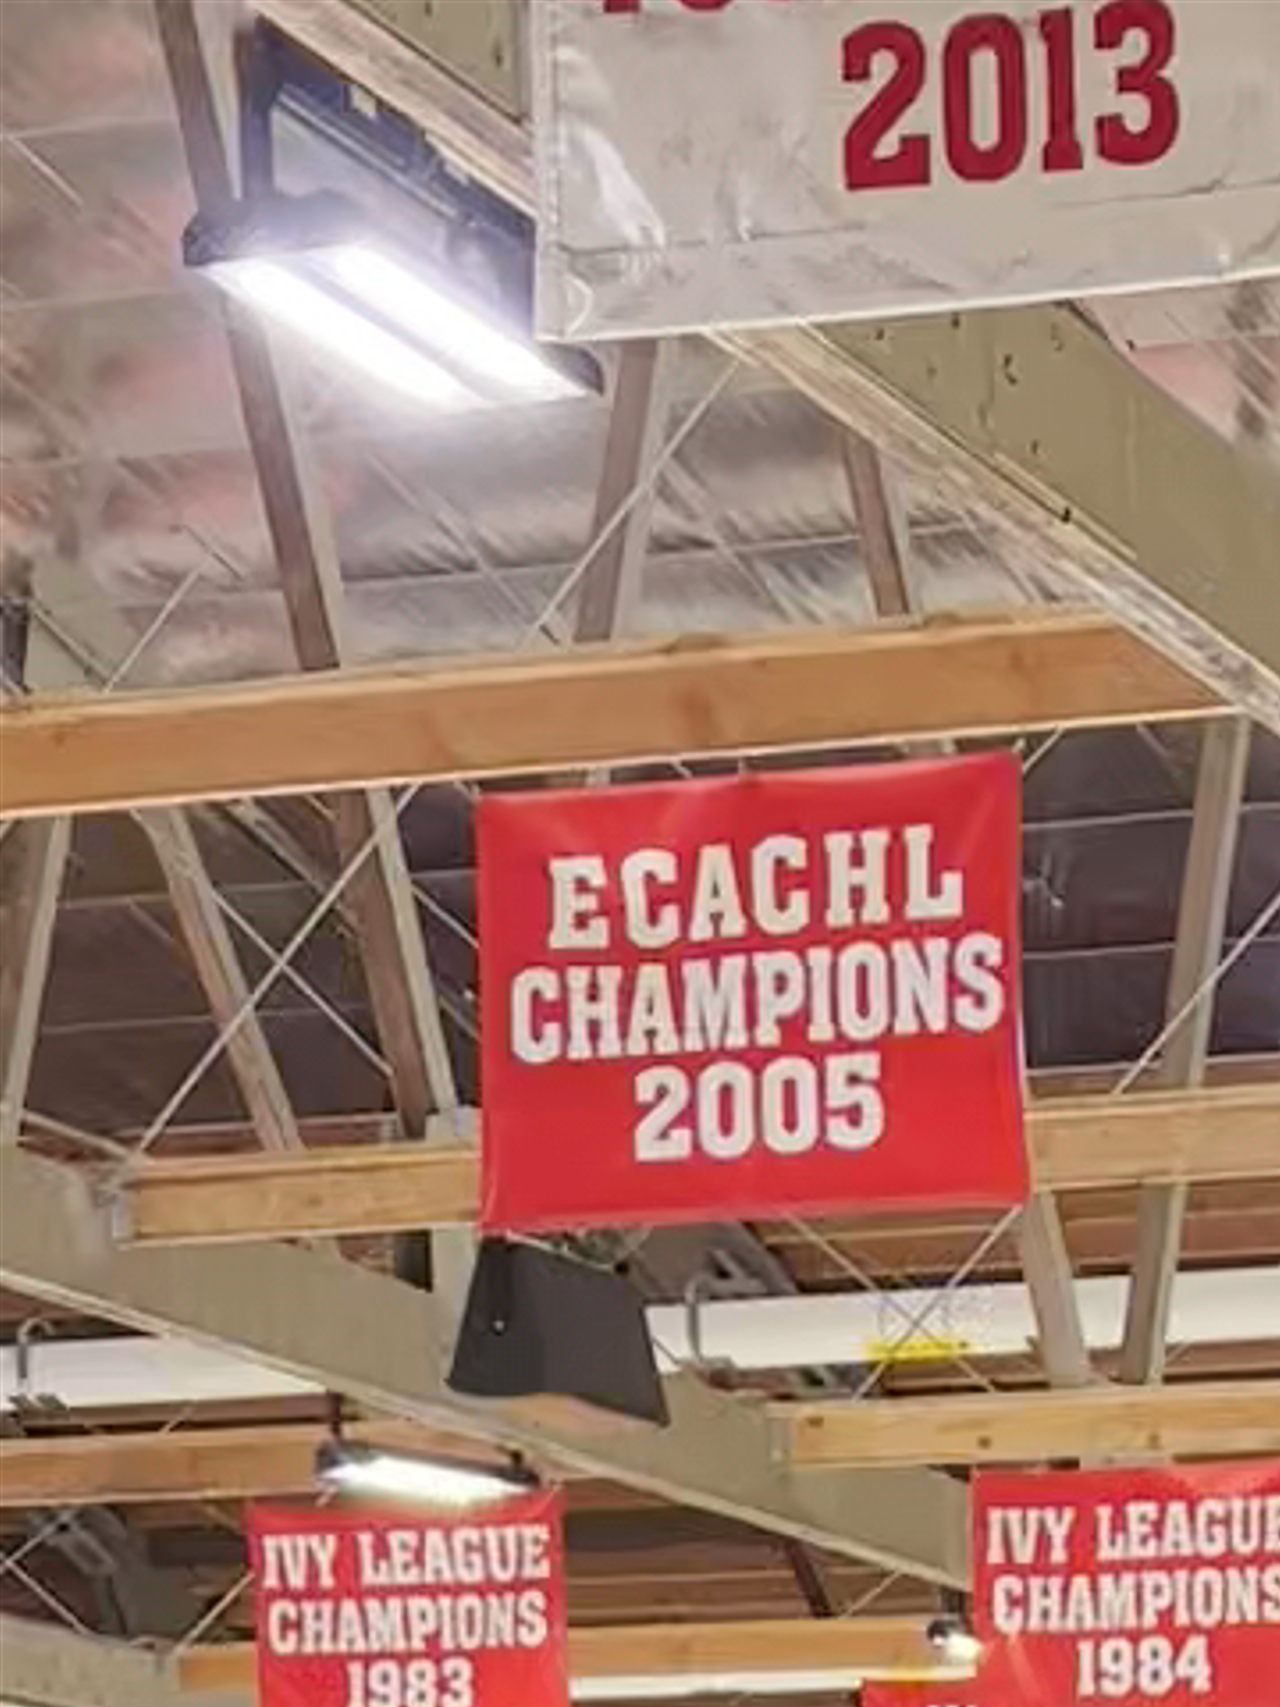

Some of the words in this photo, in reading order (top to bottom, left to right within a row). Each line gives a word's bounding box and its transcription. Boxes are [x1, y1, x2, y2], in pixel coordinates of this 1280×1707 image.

[841, 0, 1183, 192] 2013
[546, 822, 963, 955] ECACHL
[510, 933, 1003, 1066] CHAMPIONS
[634, 1053, 886, 1167] 2005
[261, 1534, 338, 1592] IVY
[359, 1523, 552, 1585] LEAGUE
[986, 1506, 1077, 1566] IVY
[267, 1590, 548, 1656] CHAMPIONS
[1076, 1636, 1212, 1700] 1984
